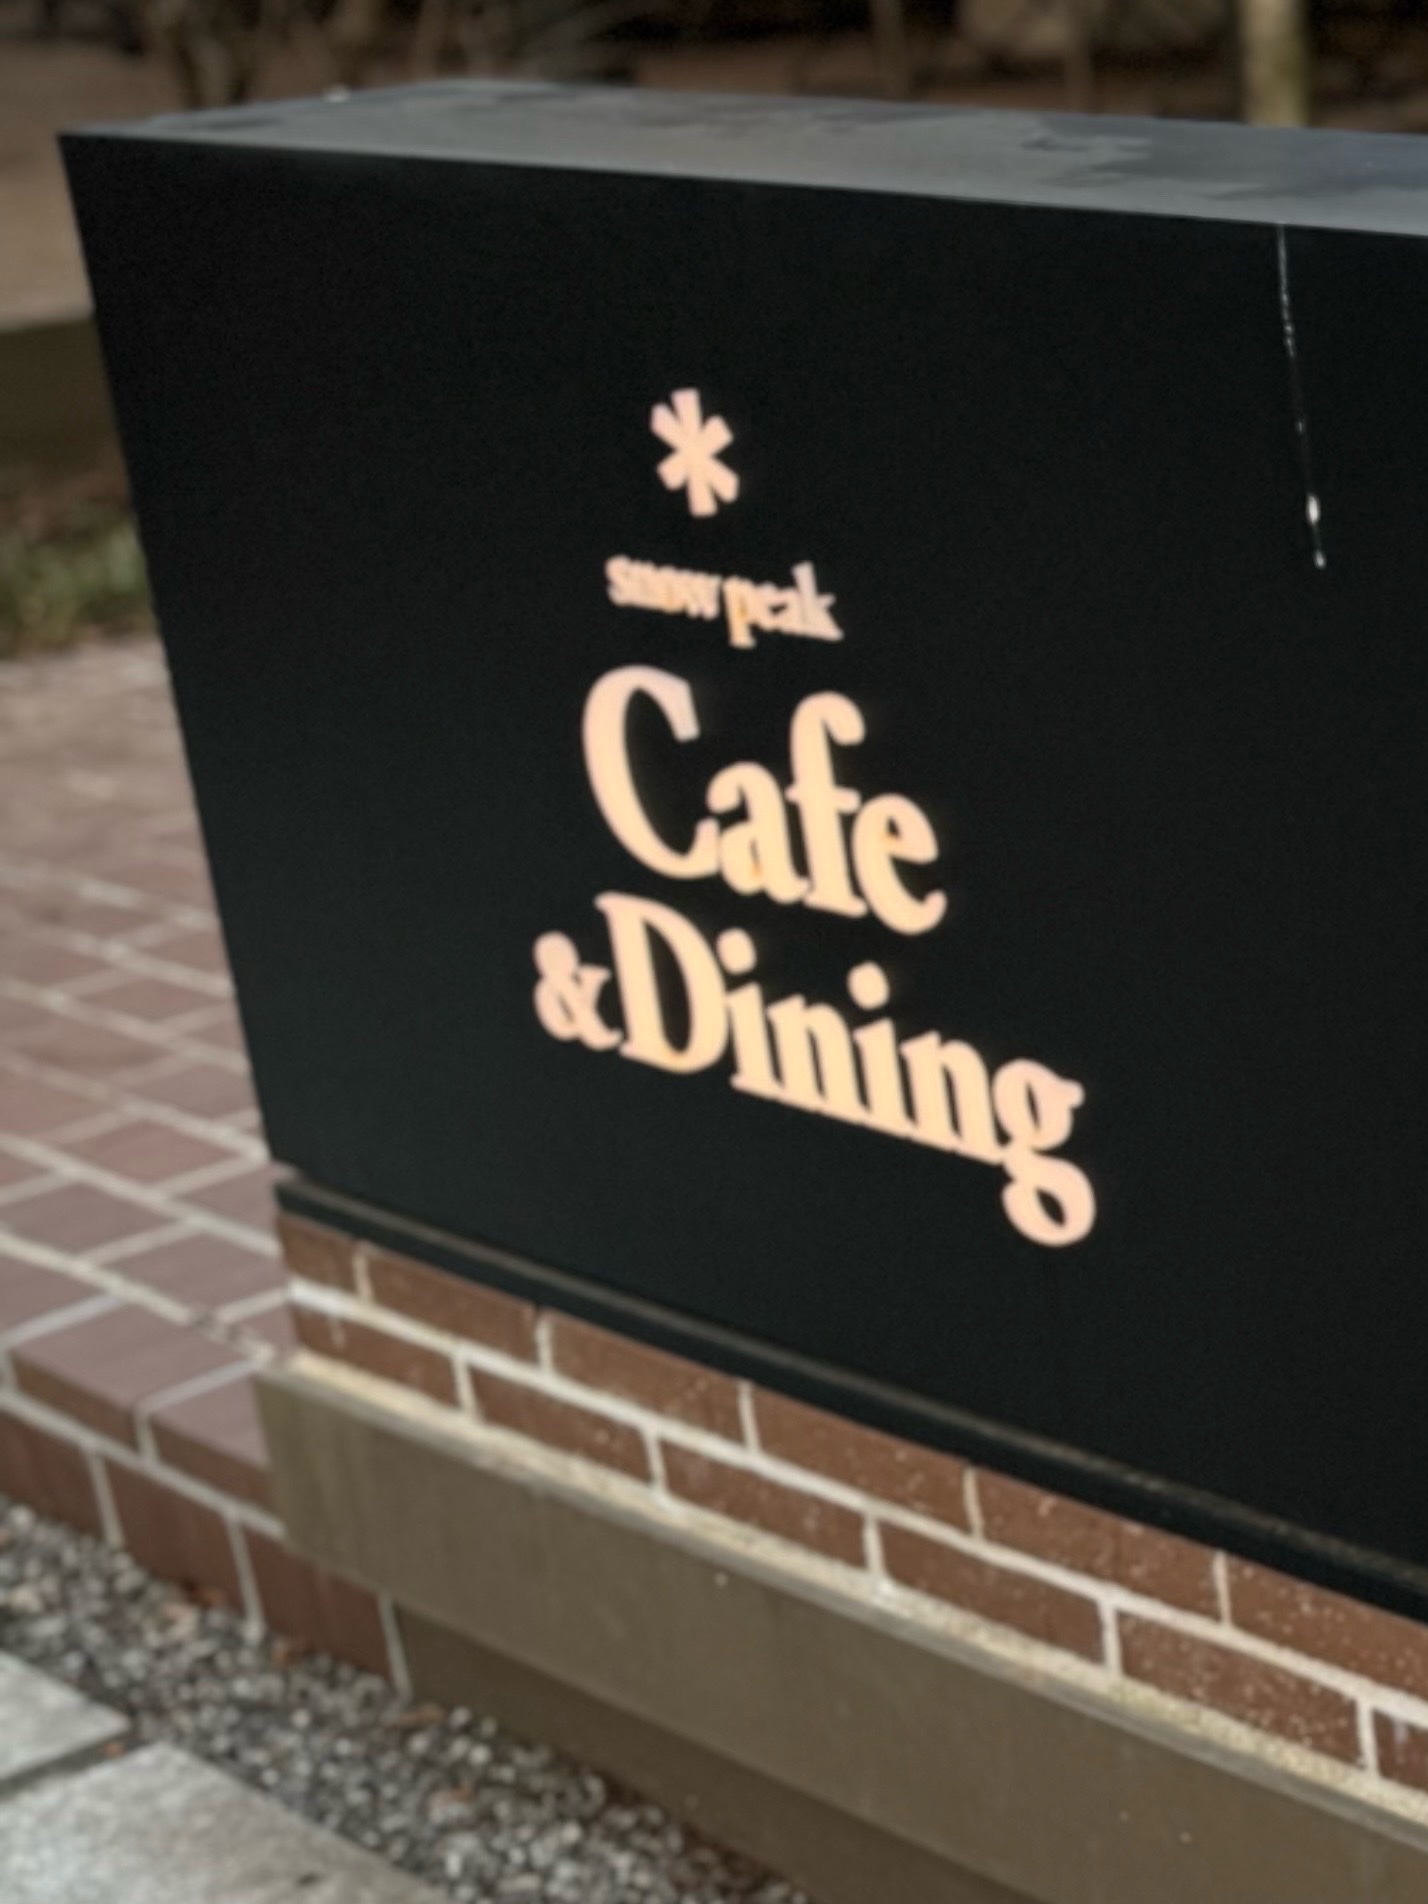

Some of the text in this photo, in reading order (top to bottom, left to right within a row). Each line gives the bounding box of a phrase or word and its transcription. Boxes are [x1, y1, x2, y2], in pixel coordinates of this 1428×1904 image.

[605, 555, 844, 649] snow peak
[582, 665, 948, 935] Cafe
